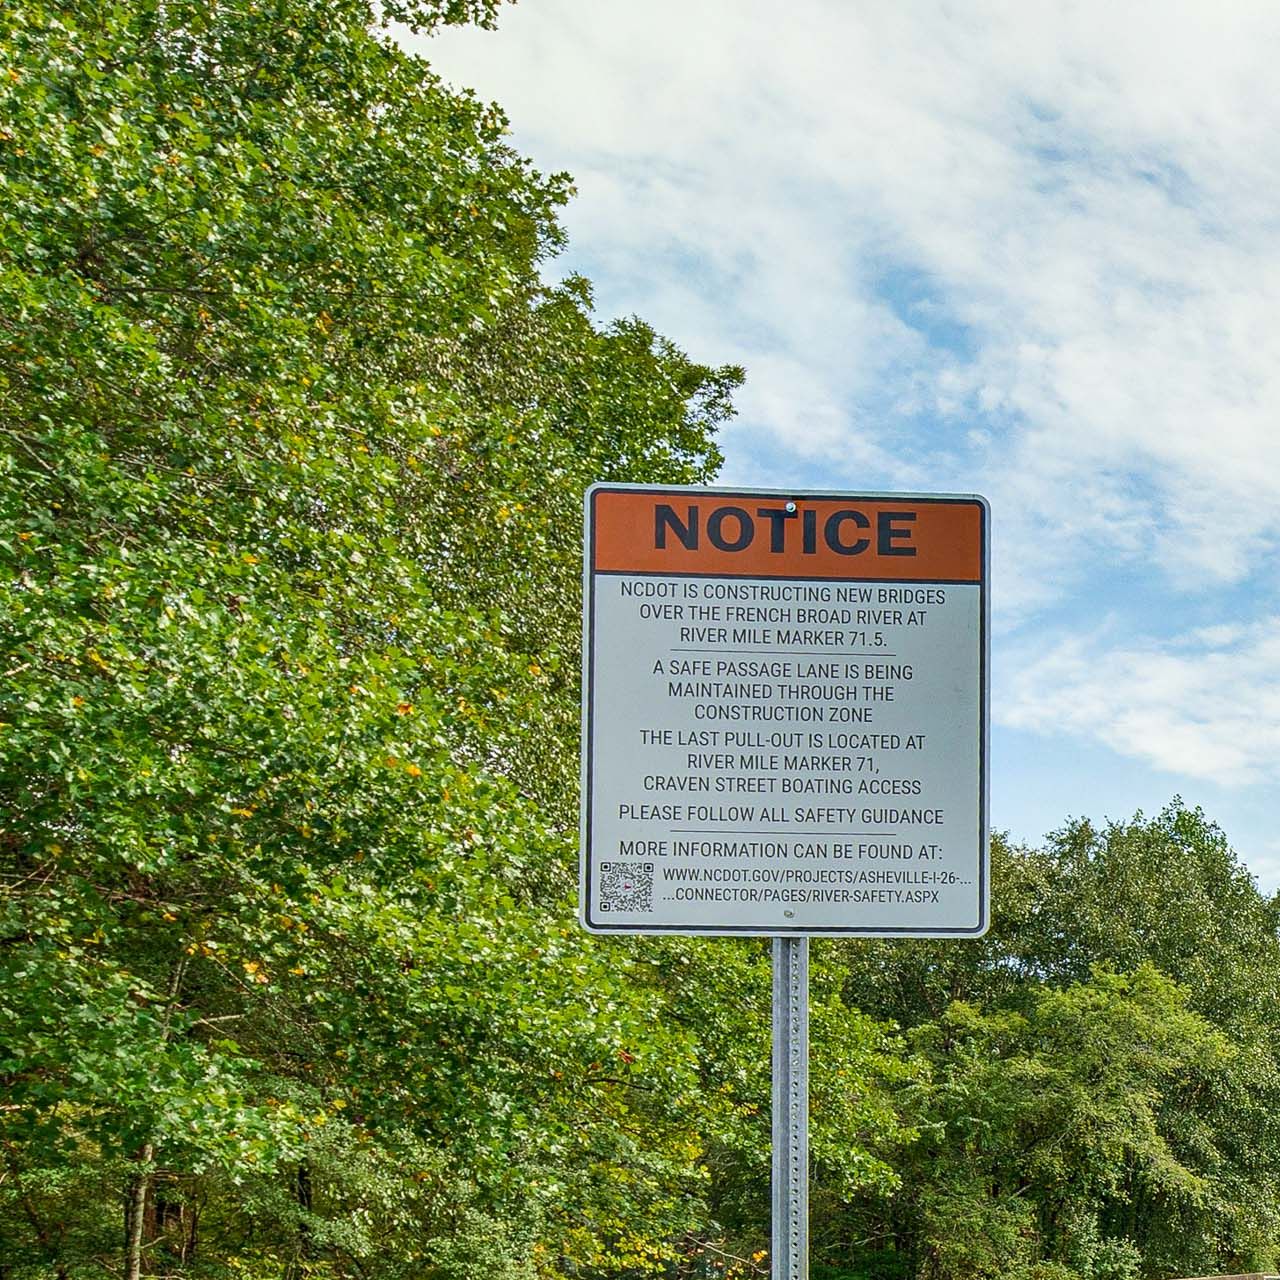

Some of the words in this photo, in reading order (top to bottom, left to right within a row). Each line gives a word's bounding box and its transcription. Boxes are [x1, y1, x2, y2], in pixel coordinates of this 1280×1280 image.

[654, 504, 917, 557] NOTICE
[622, 582, 678, 597] NCDOT
[684, 584, 697, 598] IS
[704, 585, 830, 601] CONSTRUCTING
[837, 588, 872, 602] NEW
[879, 589, 945, 604] BRIDGES
[641, 604, 683, 619] OVER
[688, 606, 720, 620] THE
[727, 607, 790, 622] FRENCH
[798, 609, 850, 623] BROAD
[857, 610, 902, 624] RIVER
[907, 611, 927, 625] AT
[681, 628, 727, 642] RIVER
[733, 629, 771, 644] MILE
[777, 630, 843, 645] MARKER
[849, 632, 886, 646] 71.5.
[653, 660, 664, 674] A
[670, 660, 711, 675] SAFE
[717, 662, 791, 677] PASSAGE
[798, 664, 839, 678] LANE
[845, 664, 859, 679] IS
[865, 665, 912, 680] BEING
[669, 682, 772, 698] MAINTAINED
[777, 685, 856, 700] THROUGH
[862, 686, 894, 701] THE
[695, 705, 823, 721] CONSTRUCTION
[829, 708, 872, 722] ZONE
[640, 730, 672, 745] THE
[679, 731, 719, 746] LAST
[725, 732, 803, 747] PULL-OUT
[809, 734, 822, 748] IS
[829, 734, 900, 749] LOCATED
[906, 735, 925, 749] AT
[688, 754, 734, 769] RIVER
[741, 755, 778, 769] MILE
[785, 756, 851, 771] MARKER
[857, 757, 879, 774] 71,
[644, 776, 709, 791] CRAVEN
[716, 777, 776, 792] STREET
[783, 779, 852, 793] BOATING
[858, 780, 921, 794] ACCESS
[620, 805, 681, 820] PLEASE
[688, 806, 754, 821] FOLLOW
[760, 808, 789, 822] ALL
[795, 808, 856, 822] SAFETY
[862, 809, 943, 824] GUIDANCE
[620, 841, 667, 856] MORE
[674, 842, 787, 857] INFORMATION
[794, 844, 827, 858] CAN
[834, 844, 852, 858] BE
[859, 845, 912, 859] FOUND
[919, 845, 942, 859] AT:
